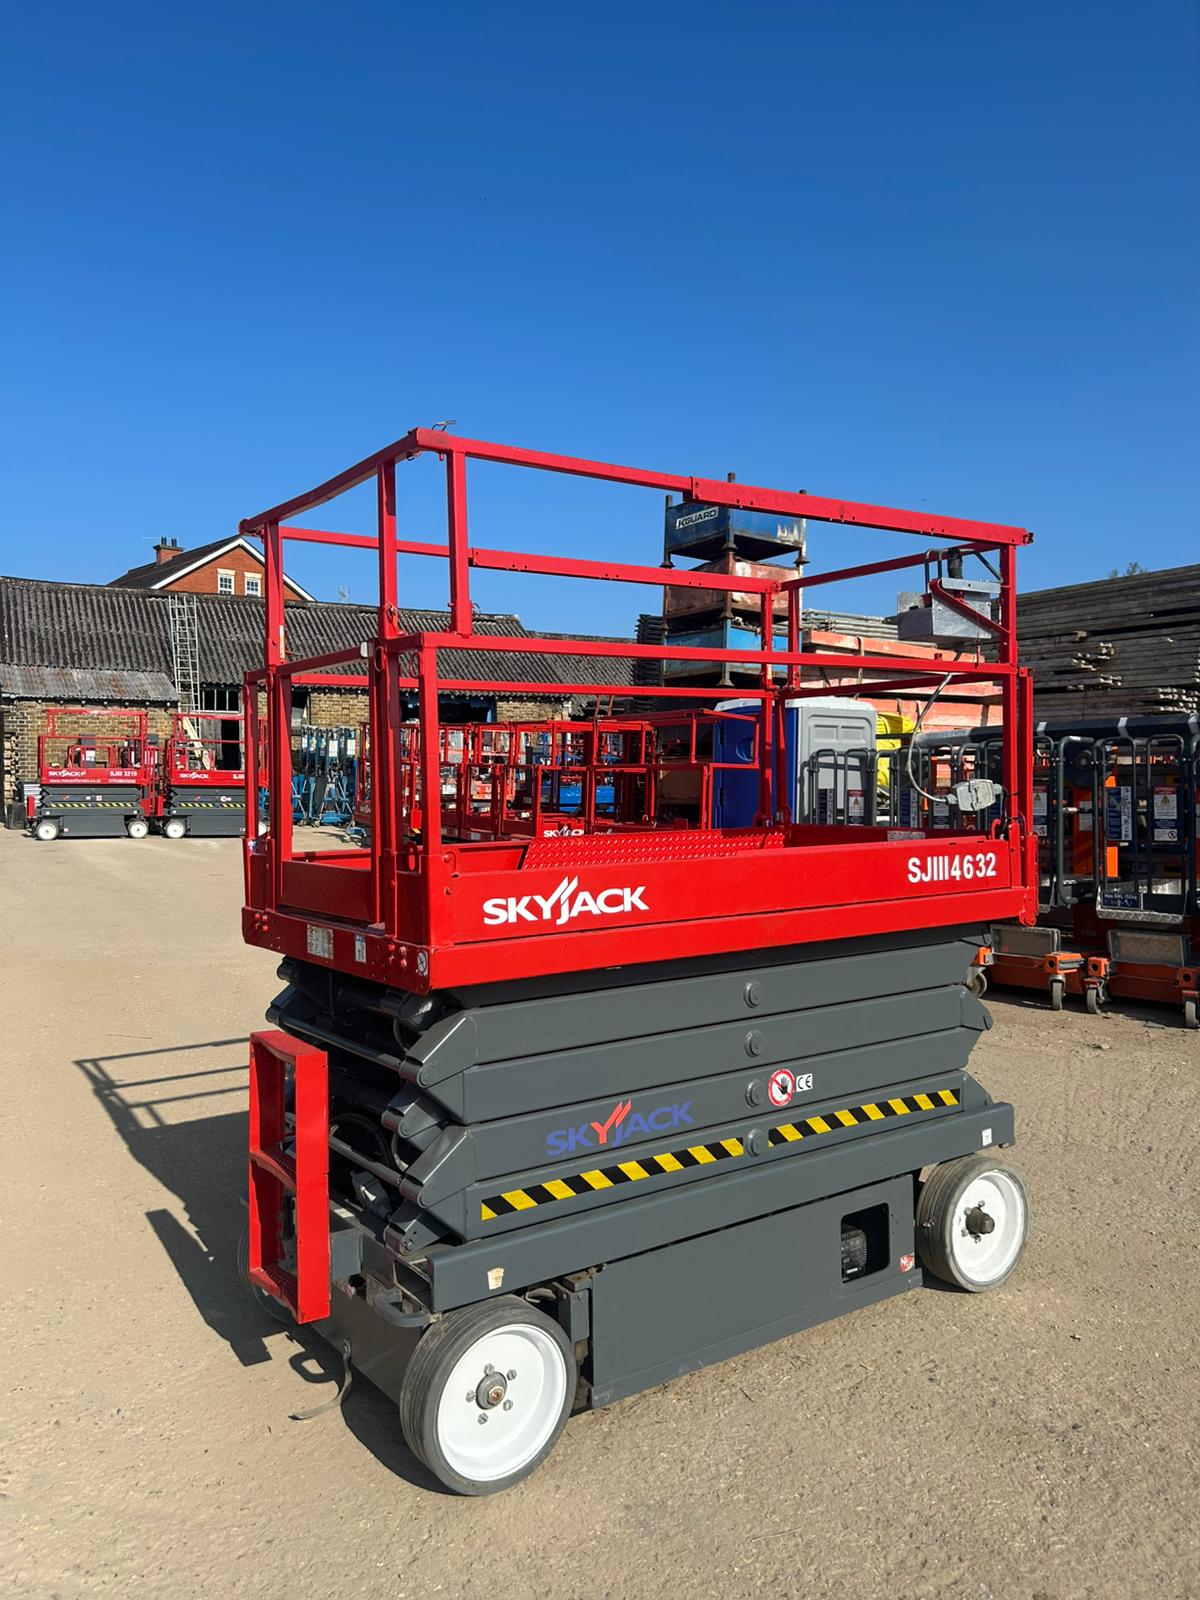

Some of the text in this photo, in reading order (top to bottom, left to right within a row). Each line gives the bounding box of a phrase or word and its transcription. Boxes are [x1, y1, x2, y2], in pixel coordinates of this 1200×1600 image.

[679, 509, 717, 527] KGUARD
[48, 769, 80, 777] SKYJACK
[180, 771, 208, 779] SKYJACK
[482, 875, 649, 925] SKYJACK
[546, 1099, 694, 1157] SKYJACK
